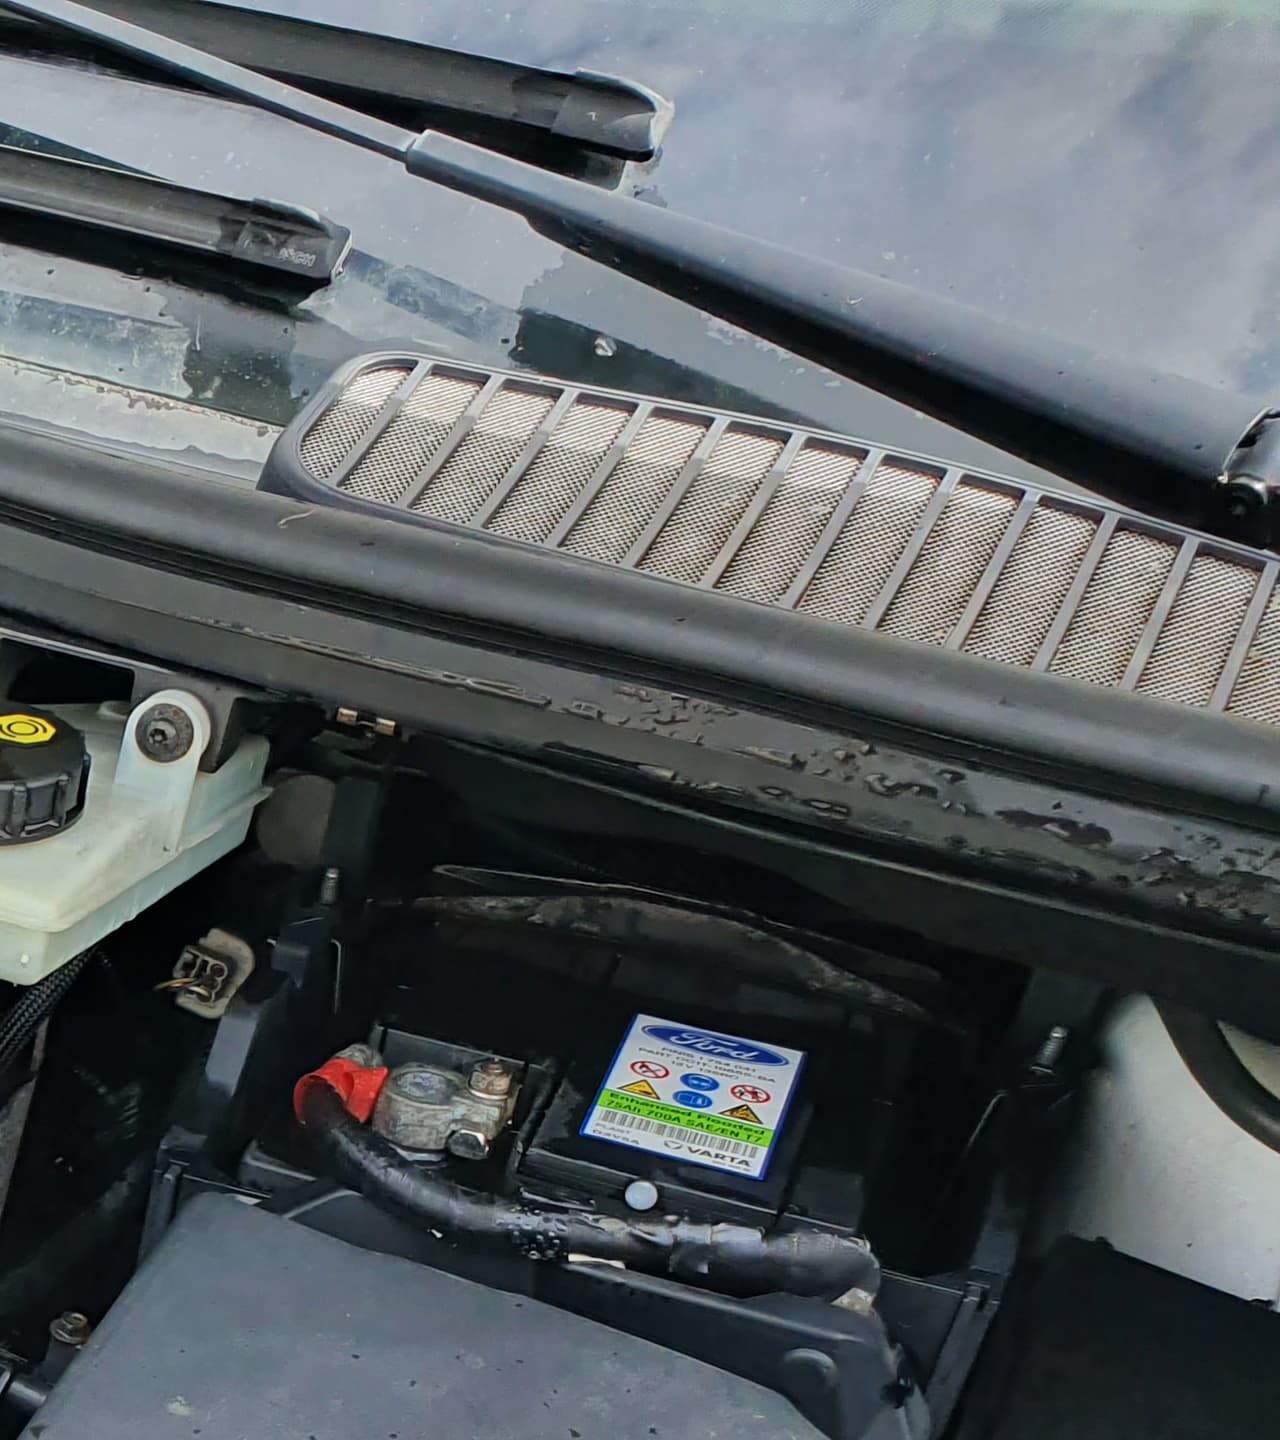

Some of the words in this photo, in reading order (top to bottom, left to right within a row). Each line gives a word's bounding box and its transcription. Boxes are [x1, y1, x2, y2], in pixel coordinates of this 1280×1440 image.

[670, 1032, 760, 1061] Ford
[606, 1098, 642, 1113] 75Ah
[644, 1108, 682, 1124] 700A
[685, 1118, 744, 1139] SAE/EN
[608, 1091, 692, 1117] Enhanced
[695, 1113, 765, 1136] Flooded
[686, 1145, 752, 1168] VARTA
